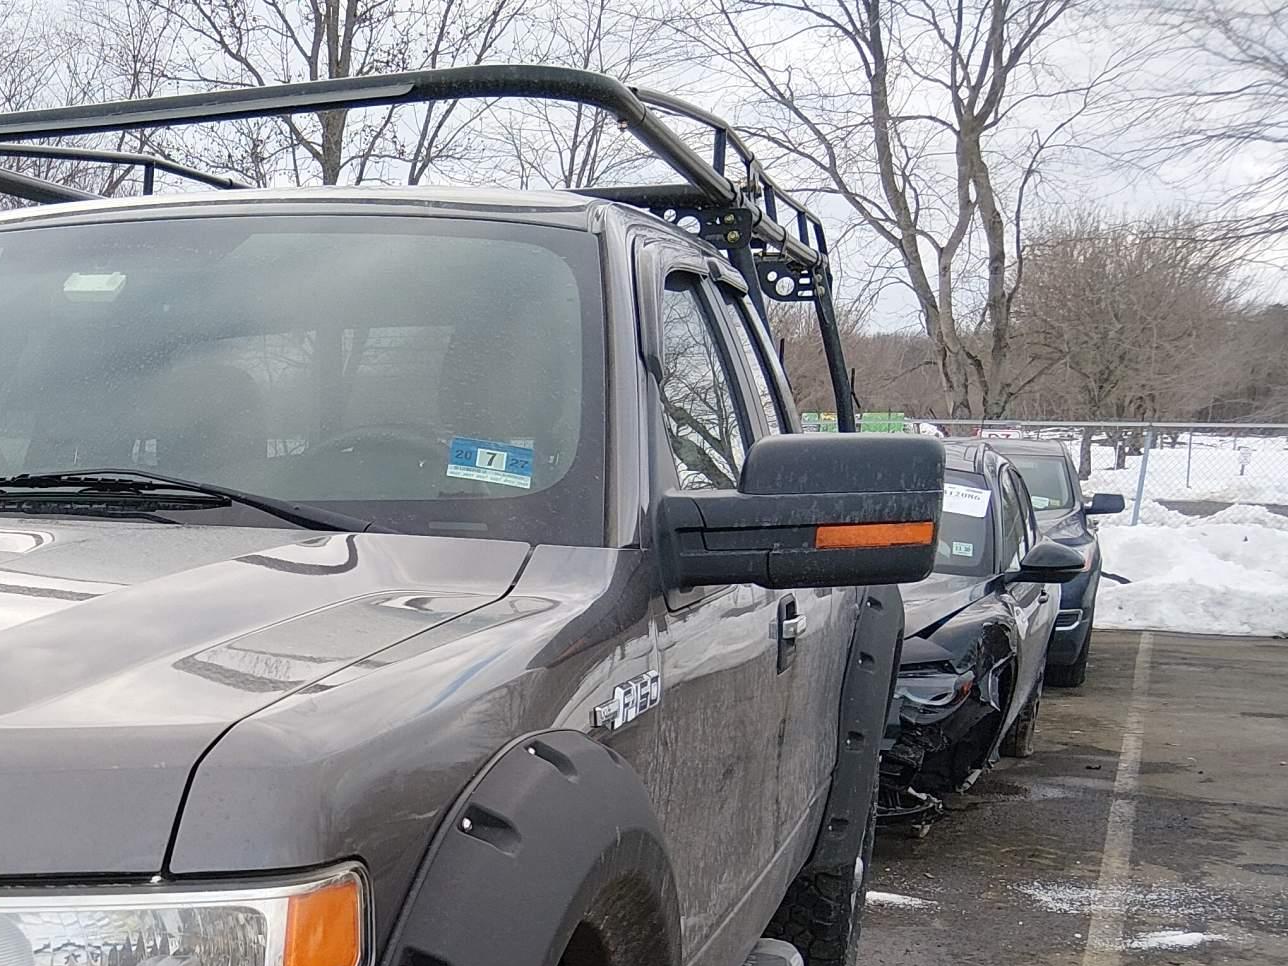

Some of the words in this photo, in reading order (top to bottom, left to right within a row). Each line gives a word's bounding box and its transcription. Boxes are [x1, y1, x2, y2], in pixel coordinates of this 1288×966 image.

[455, 449, 473, 459] 20
[486, 452, 497, 466] 7
[509, 457, 529, 469] 27
